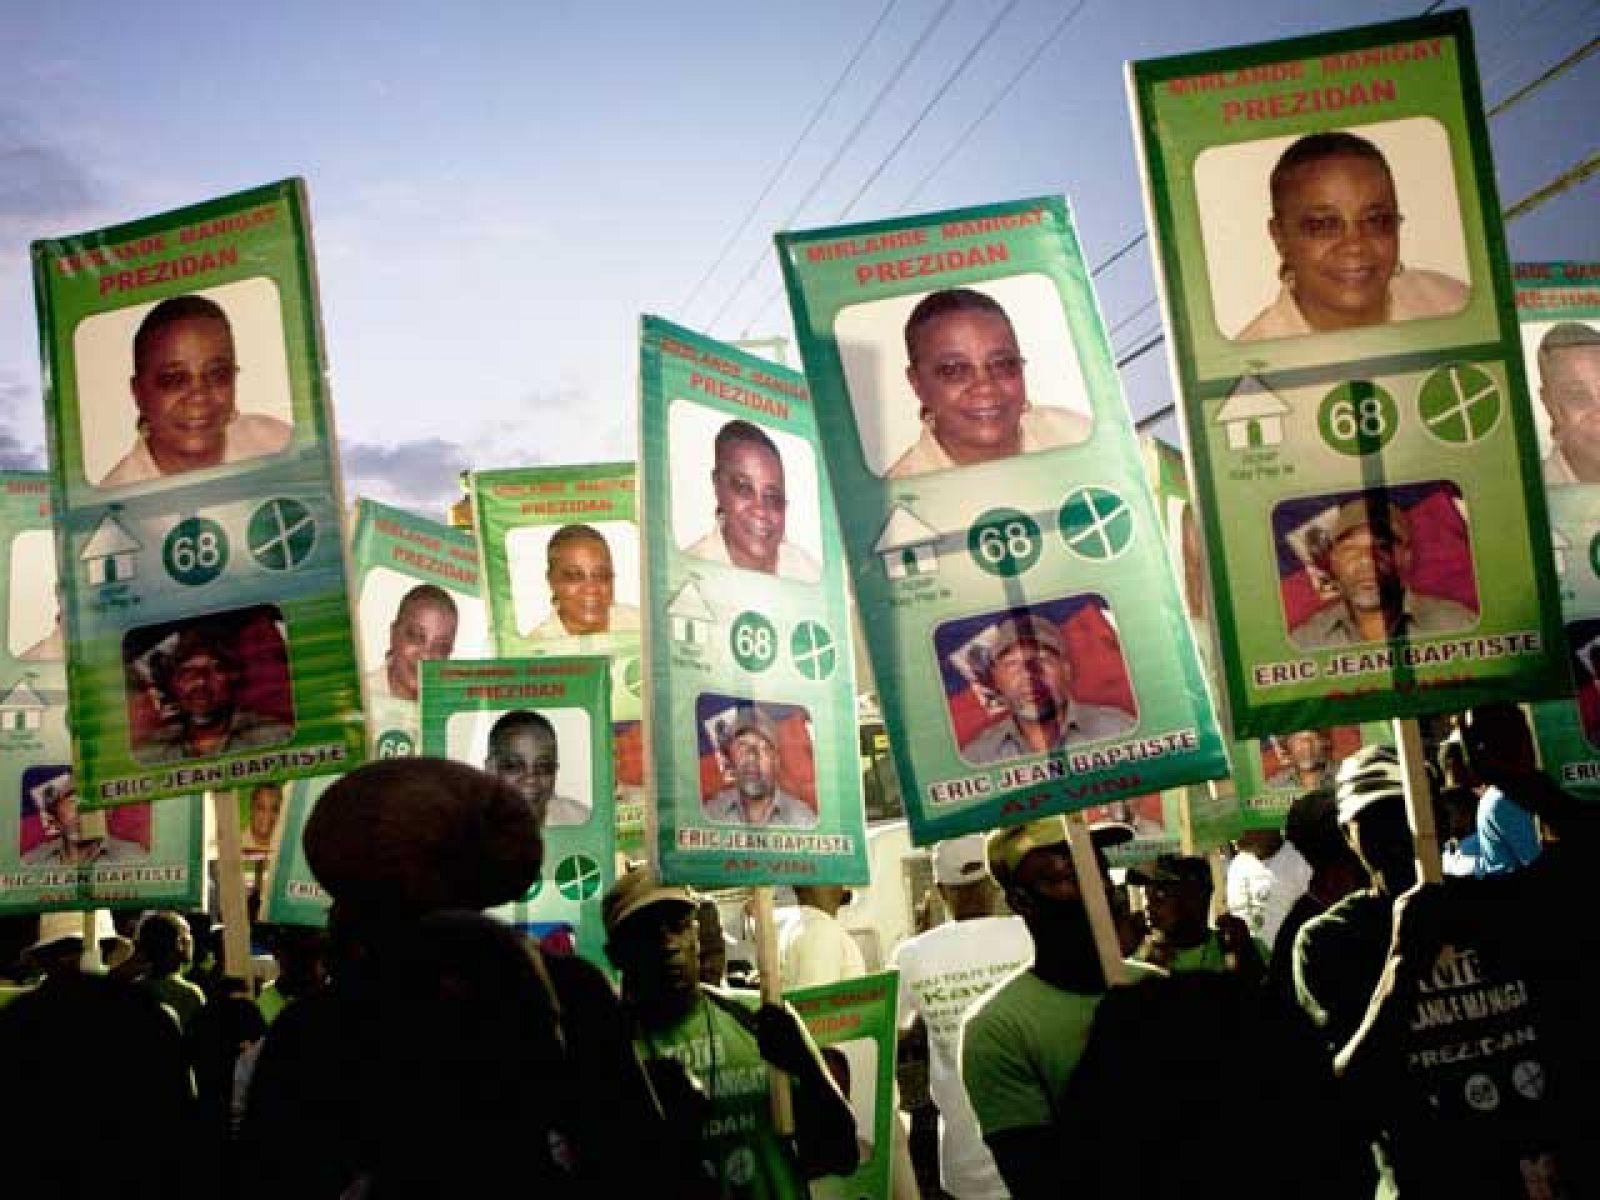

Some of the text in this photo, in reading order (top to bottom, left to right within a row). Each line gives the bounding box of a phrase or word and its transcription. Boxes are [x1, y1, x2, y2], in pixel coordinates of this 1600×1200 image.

[1222, 80, 1397, 124] PREZIDAN
[99, 248, 239, 297] PREZIDAN
[856, 241, 1009, 287] PREZIDAN
[689, 371, 790, 420] PREZIDAN
[1329, 399, 1386, 441] 68
[172, 531, 218, 572] 68
[979, 521, 1032, 564] 68
[739, 624, 772, 659] 68
[1254, 632, 1540, 687] ERIC JEAN BAPTISTE
[100, 743, 346, 799] ERIC JEAN BAPTISTE
[930, 731, 1198, 804] ERIC JEAN BAPTISTE
[1002, 793, 1050, 815] AP
[678, 828, 853, 853] ERIC JEAN BAPTISTE
[97, 867, 187, 885] BAPTISTE
